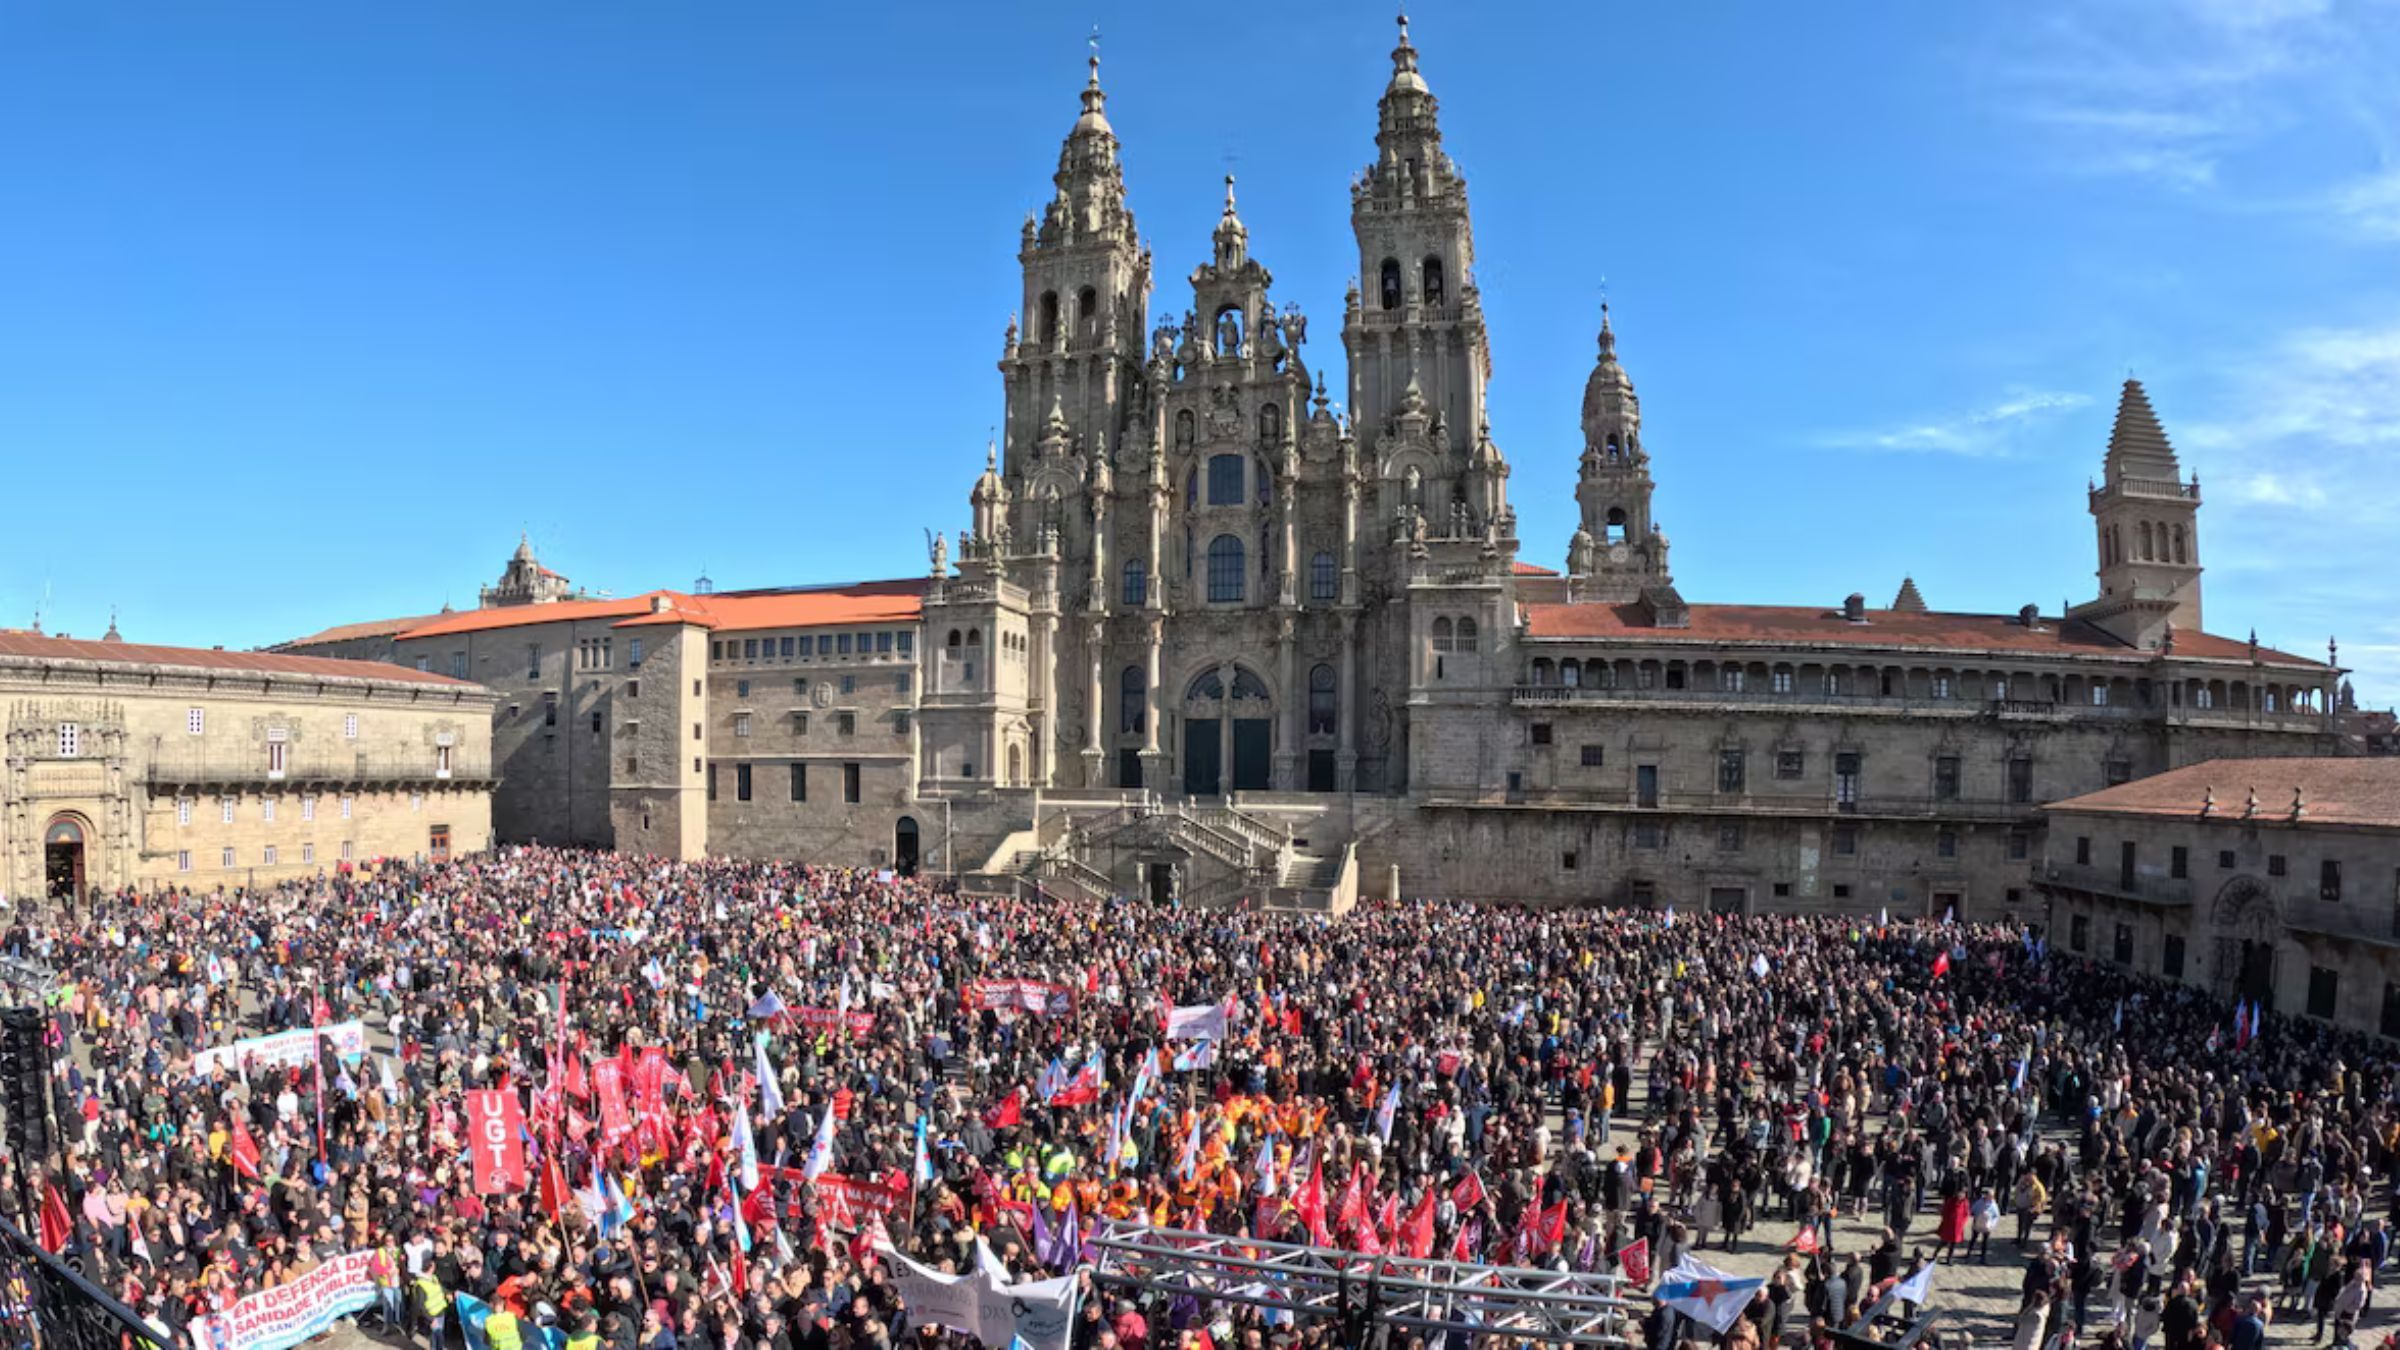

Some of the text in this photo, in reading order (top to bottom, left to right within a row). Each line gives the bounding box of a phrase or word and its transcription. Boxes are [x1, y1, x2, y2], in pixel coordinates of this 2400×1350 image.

[482, 1094, 507, 1168] UGT
[234, 1297, 257, 1319] EN
[263, 1258, 339, 1308] DEFENSA
[235, 1296, 312, 1335] SANIDADE
